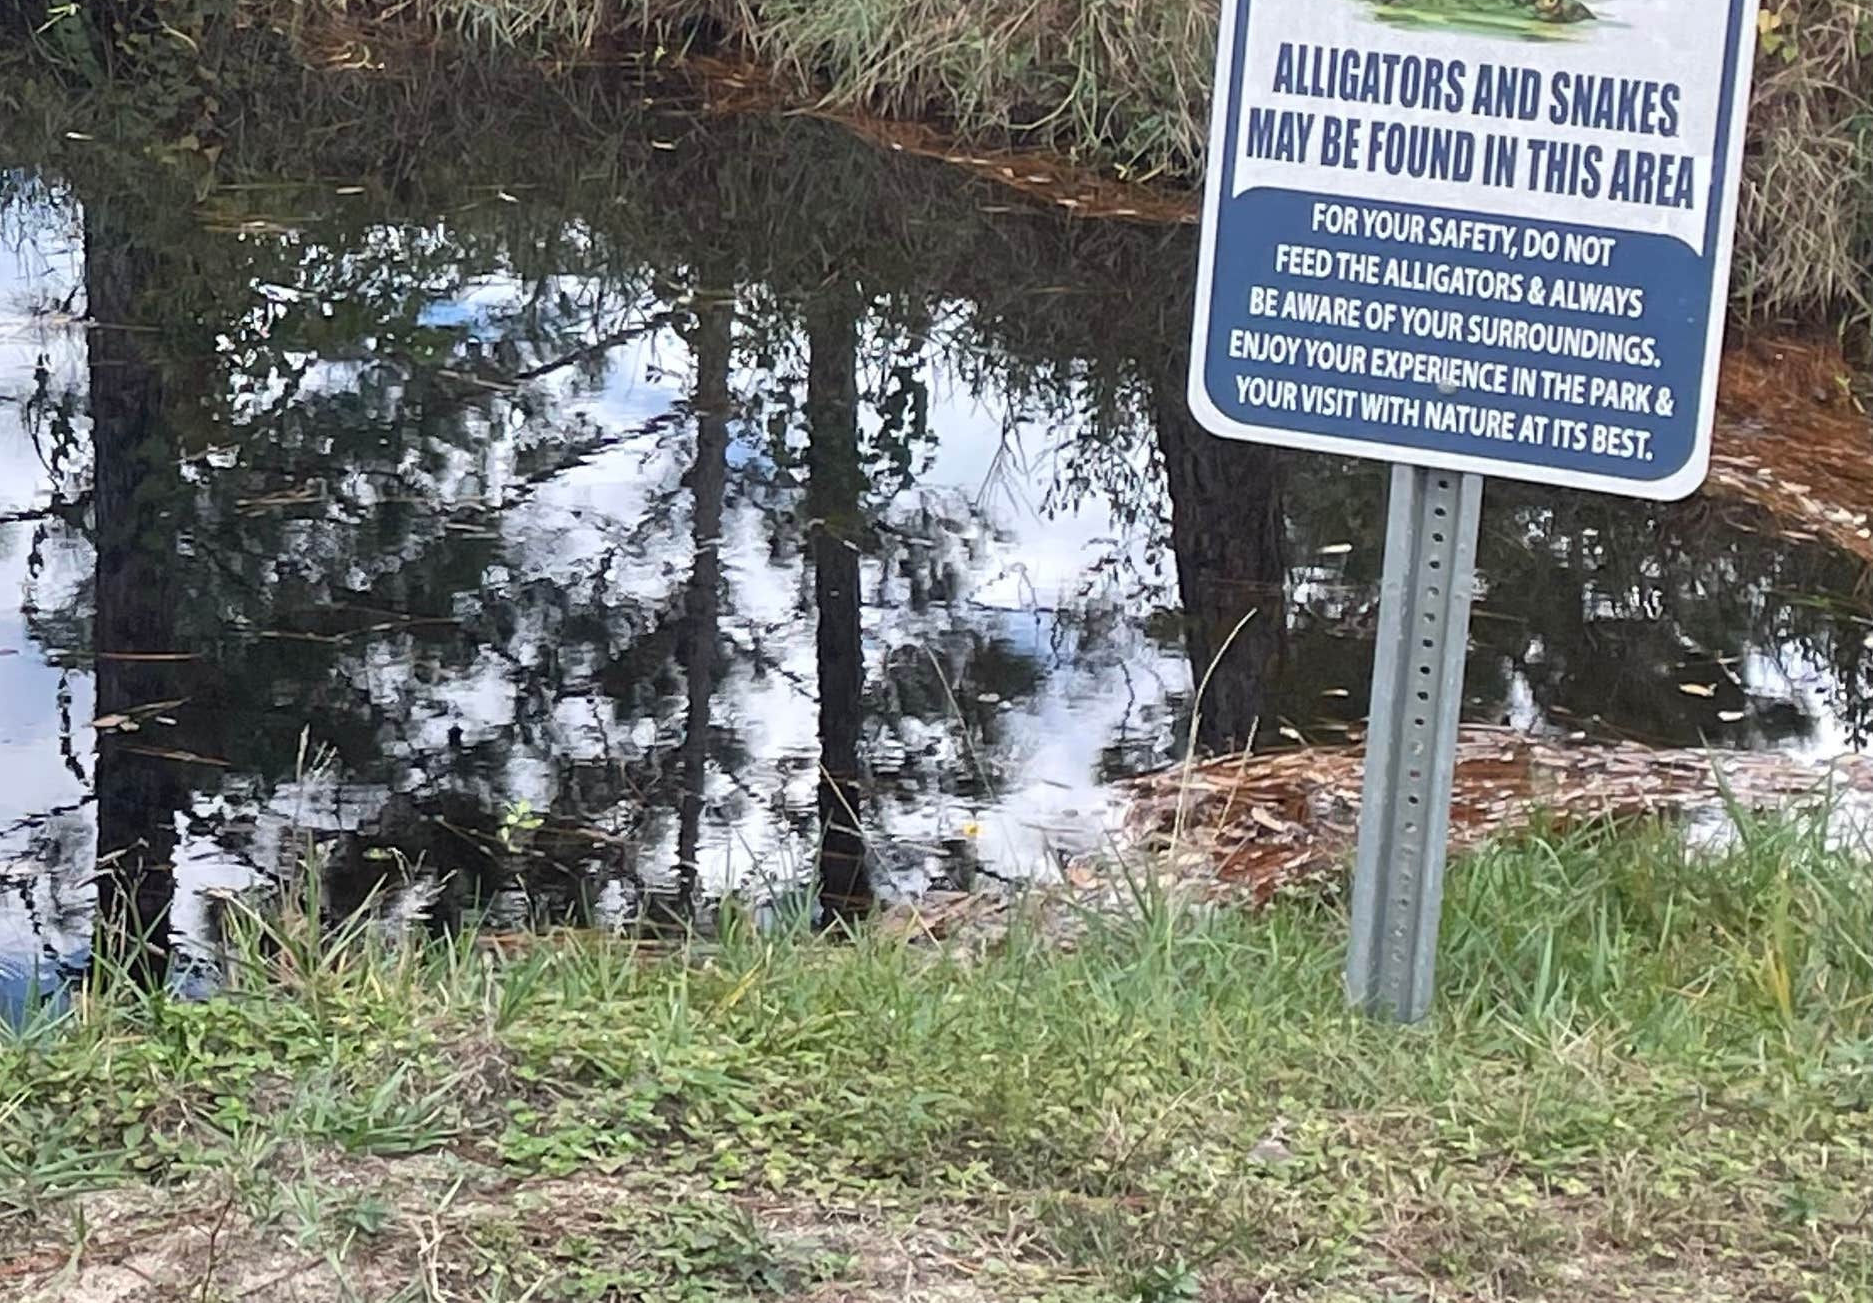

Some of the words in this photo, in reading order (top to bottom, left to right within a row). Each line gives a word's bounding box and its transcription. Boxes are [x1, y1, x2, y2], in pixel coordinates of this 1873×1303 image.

[1273, 43, 1466, 113] ALLIGATORS
[1472, 64, 1541, 120] AND
[1550, 71, 1680, 137] SNAKES
[1246, 107, 1314, 163] MAY
[1321, 115, 1360, 169] BE
[1367, 121, 1474, 183] FOUND
[1483, 134, 1519, 188] IN
[1527, 139, 1603, 197] THIS
[1609, 149, 1695, 209] AREA
[1312, 203, 1358, 236] FOR
[1363, 208, 1425, 243] YOUR
[1429, 217, 1517, 260] SAFETY,
[1523, 229, 1560, 259] DO
[1565, 234, 1615, 267] NOT
[1276, 244, 1332, 278] FEED
[1336, 252, 1381, 284] THE
[1383, 258, 1524, 302] ALLIGATORS
[1527, 276, 1546, 306] &
[1549, 279, 1643, 318] ALWAYS
[1249, 286, 1279, 317] BE
[1281, 291, 1362, 328] AWARE
[1365, 301, 1398, 332] OF
[1401, 305, 1463, 342] YOUR
[1467, 316, 1661, 368] SURROUNDINGS.
[1229, 329, 1301, 365] ENJOY
[1304, 339, 1367, 374] YOUR
[1370, 347, 1508, 394] EXPERIENCE
[1511, 367, 1537, 398] IN
[1541, 371, 1585, 404] THE
[1590, 377, 1653, 414] PARK
[1655, 387, 1675, 417] &
[1235, 375, 1297, 411] YOUR
[1301, 384, 1359, 418] VISIT
[1361, 392, 1420, 426] WITH
[1424, 400, 1517, 441] NATURE
[1518, 414, 1549, 444] AT
[1552, 418, 1588, 452] ITS
[1592, 424, 1653, 461] BEST.
